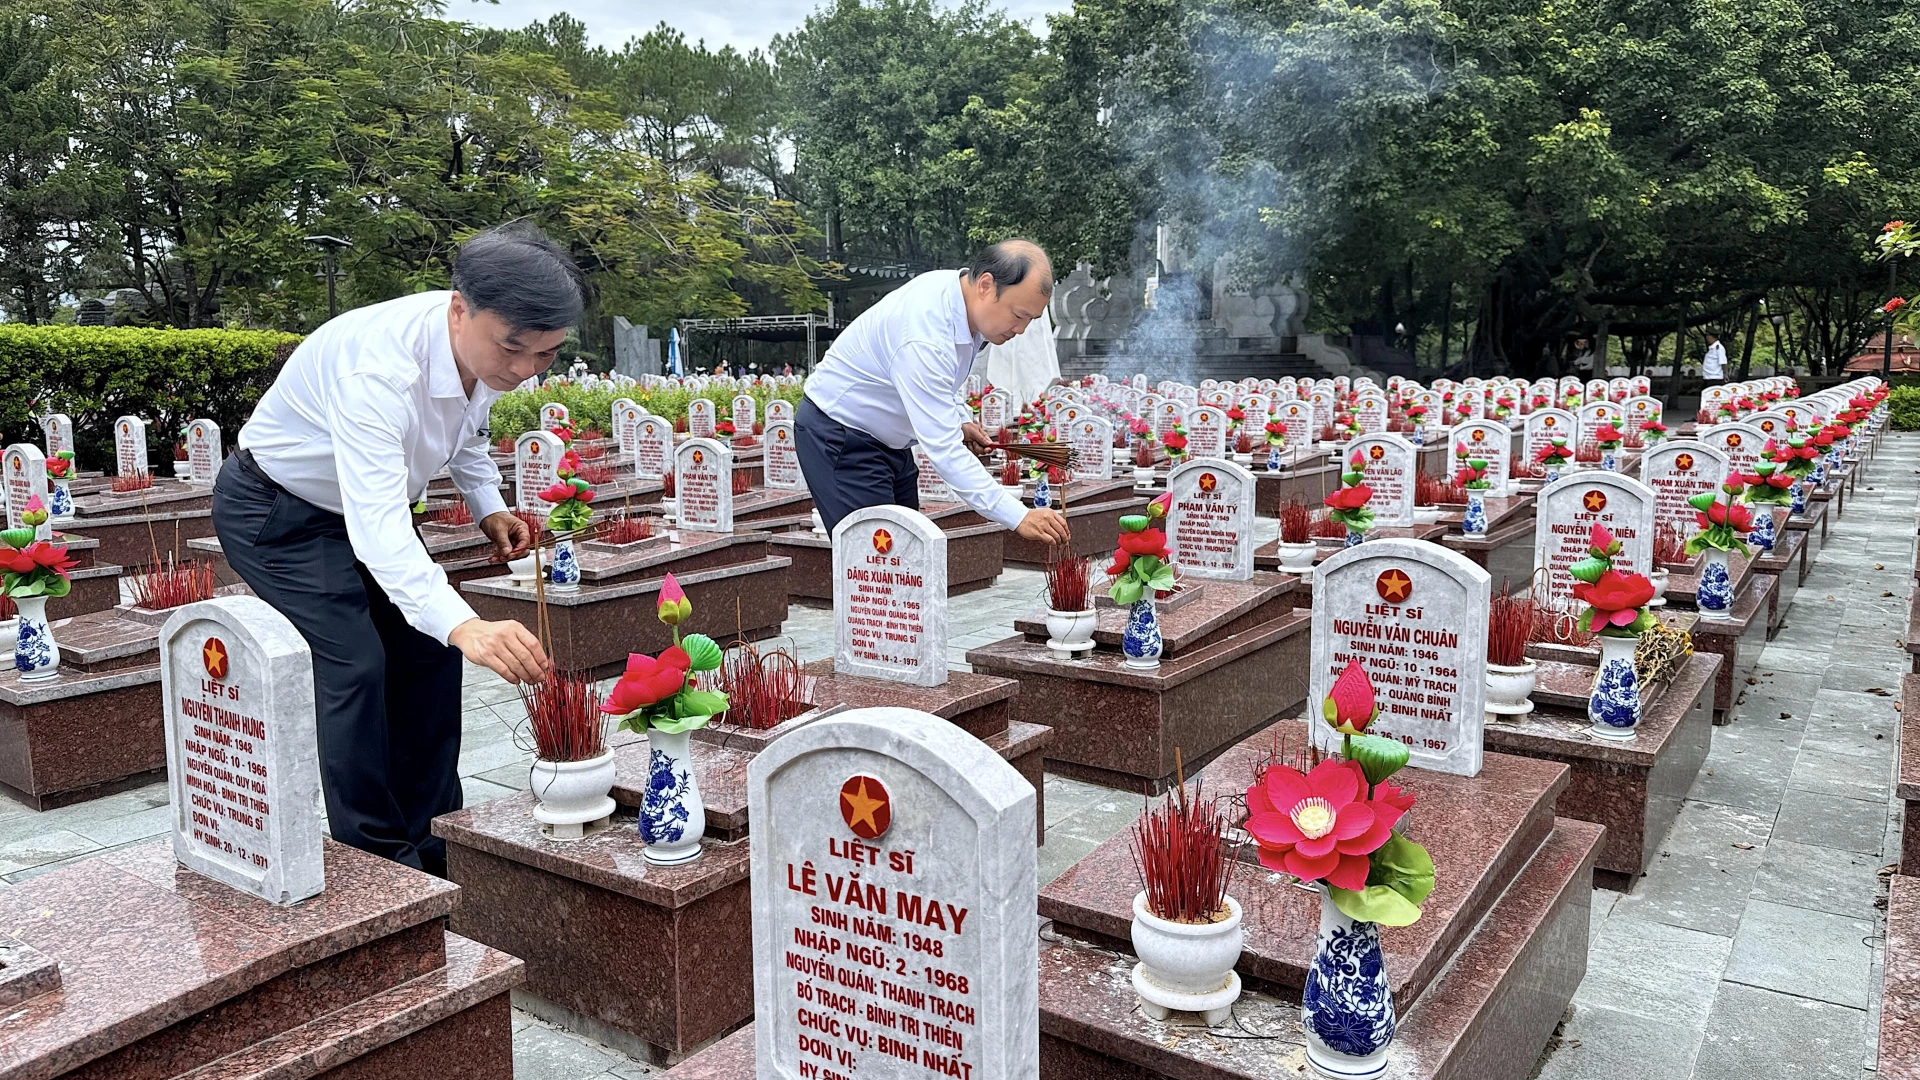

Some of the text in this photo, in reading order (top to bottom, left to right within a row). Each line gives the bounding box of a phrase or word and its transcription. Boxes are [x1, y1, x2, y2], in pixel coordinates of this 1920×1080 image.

[1206, 503, 1224, 513] VĂN
[1574, 512, 1614, 522] LIỆT SĨ
[867, 554, 901, 566] LIỆT SĨ
[847, 566, 922, 587] ĐẶNG XUÂN THẮNG
[859, 584, 874, 592] SINH
[1366, 603, 1424, 620] LIỆT SĨ
[885, 632, 908, 642] TRUNG
[910, 634, 916, 644] SĨ
[1334, 616, 1458, 648] NGUYỄN VĂN CHUÂN
[904, 658, 918, 666] 1973
[1350, 641, 1439, 661] SINH NĂM: 1946
[1370, 657, 1399, 670] NGŨ:
[1404, 663, 1417, 672] 10
[1429, 666, 1457, 678] 1964
[202, 679, 239, 701] LIỆT SĨ
[1372, 672, 1457, 694] QUÁN: MỸ TRẠCH
[1389, 687, 1424, 704] QUẢNG
[1427, 693, 1450, 707] BÌNH
[1392, 704, 1417, 716] BINH
[214, 707, 240, 732] THANH
[242, 716, 265, 740] HƯNG
[194, 725, 253, 754] SINH NĂM: 1948
[1402, 735, 1413, 744] 10
[1423, 739, 1447, 750] 1967
[185, 739, 267, 777] NHẬP NGŨ: 10 1966
[187, 757, 212, 776] NGUYÊN
[214, 766, 234, 785] QUÁN:
[236, 775, 250, 789] QUY
[186, 774, 202, 789] MINH
[222, 785, 237, 803] BÌNH
[238, 793, 249, 811] TRỊ
[250, 798, 269, 815] THIÊN
[192, 793, 263, 831] CHỨC VỤ: TRUNG SĨ
[192, 811, 208, 827] ĐƠN
[194, 828, 268, 869] HY SINH: 20 12 1971
[829, 838, 915, 875] LIỆT SĨ
[787, 861, 968, 935] LÊ VĂN MAY
[811, 906, 943, 958] SINH NĂM: 1948
[794, 928, 969, 994] NHẬP NGŨ: 2 1968
[786, 951, 974, 1026] NGUYÊN QUÁN: THANH TRẠCH
[797, 978, 962, 1050] BỐ TRẠCH BÌNH TRỊ THIÊN
[798, 1008, 972, 1080] CHỨC VỤ: BINH NHẤT
[799, 1034, 856, 1073] ĐƠN VỊ:
[800, 1060, 819, 1080] HY
